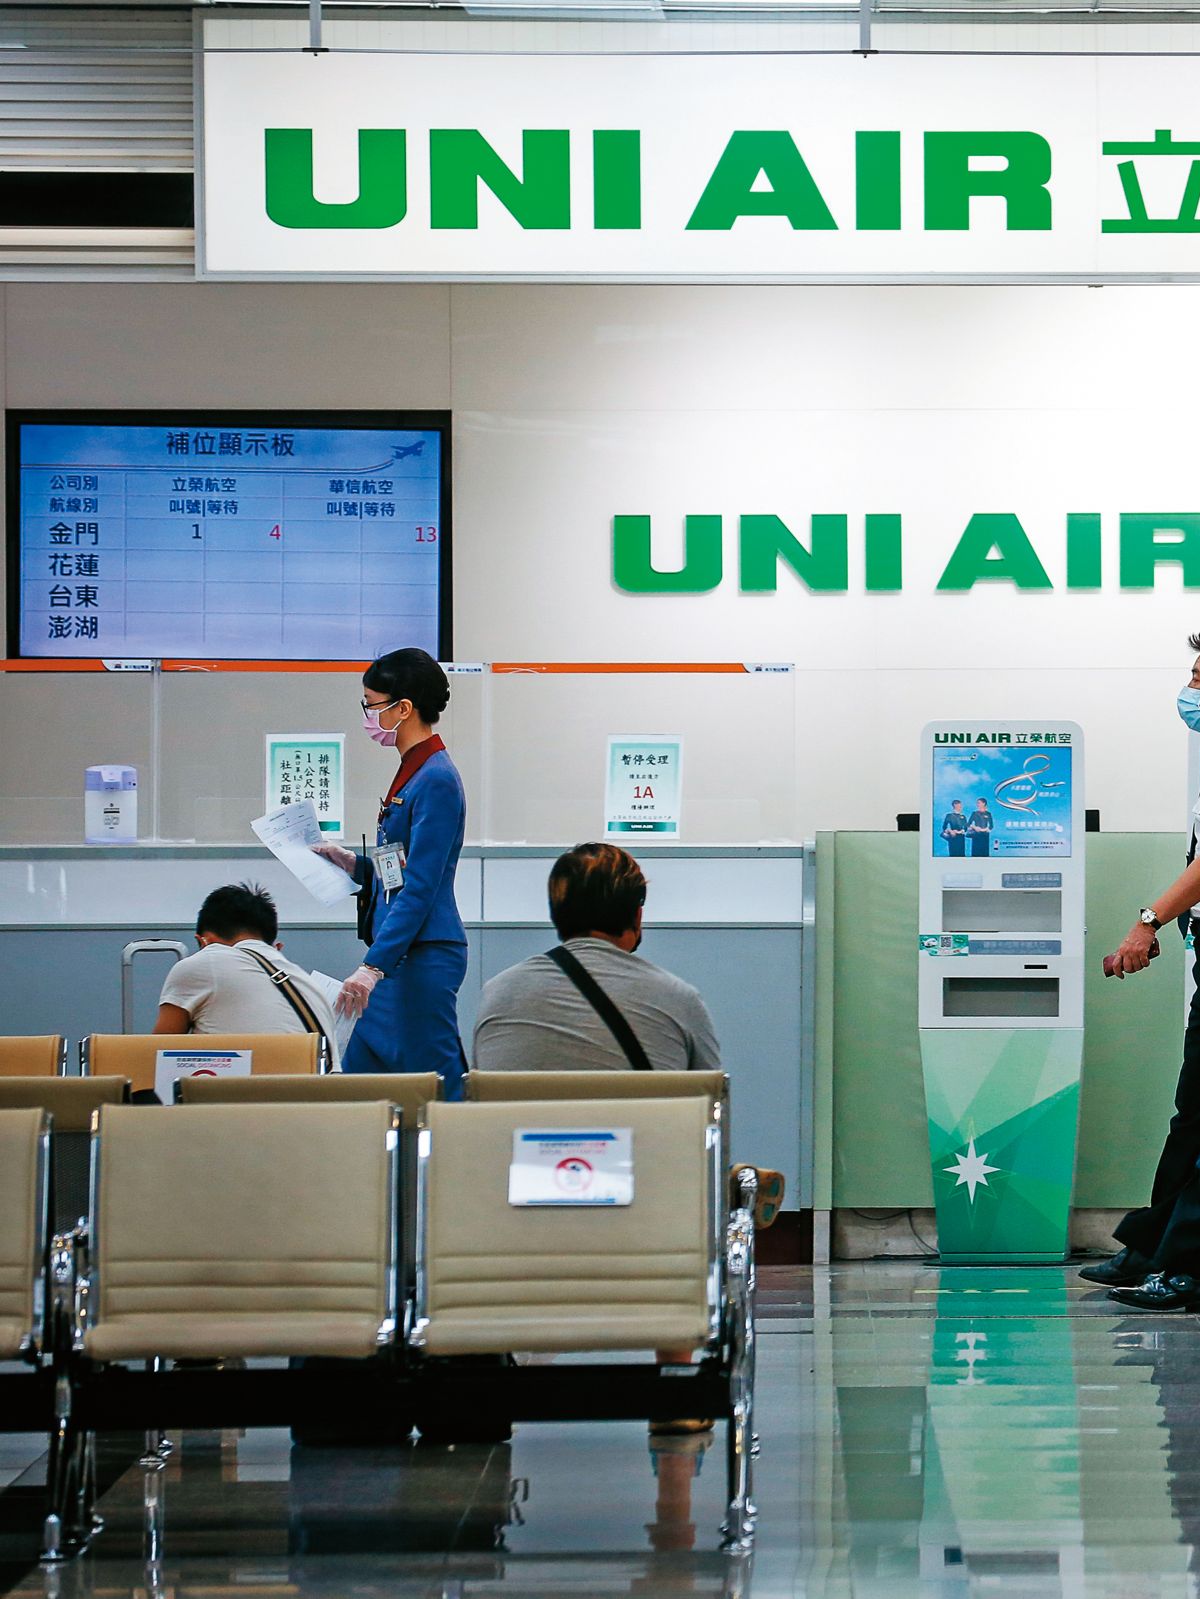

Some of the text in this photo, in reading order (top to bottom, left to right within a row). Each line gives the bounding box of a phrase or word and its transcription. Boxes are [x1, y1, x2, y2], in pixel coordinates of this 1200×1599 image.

[265, 128, 641, 230] UNI
[685, 130, 1052, 231] AIR
[166, 431, 295, 457] 補位顯示板
[50, 475, 98, 491] 公司別
[172, 477, 237, 493] 立榮航空
[329, 479, 394, 495] 華信航空
[50, 497, 98, 513] 航線別
[49, 522, 98, 545] 金門
[192, 524, 202, 540] 1
[269, 525, 281, 540] 4
[415, 526, 437, 542] 13
[613, 513, 903, 593] UNI
[49, 553, 98, 577] 花蓮
[49, 584, 98, 608] 台東
[49, 616, 98, 639] 澎湖
[935, 733, 1071, 743] UNI AIR 立榮航空
[622, 754, 669, 765] 暫停受理
[280, 760, 292, 805] 社交距離
[318, 754, 330, 811] 排隊請保持
[634, 786, 654, 798] 1A
